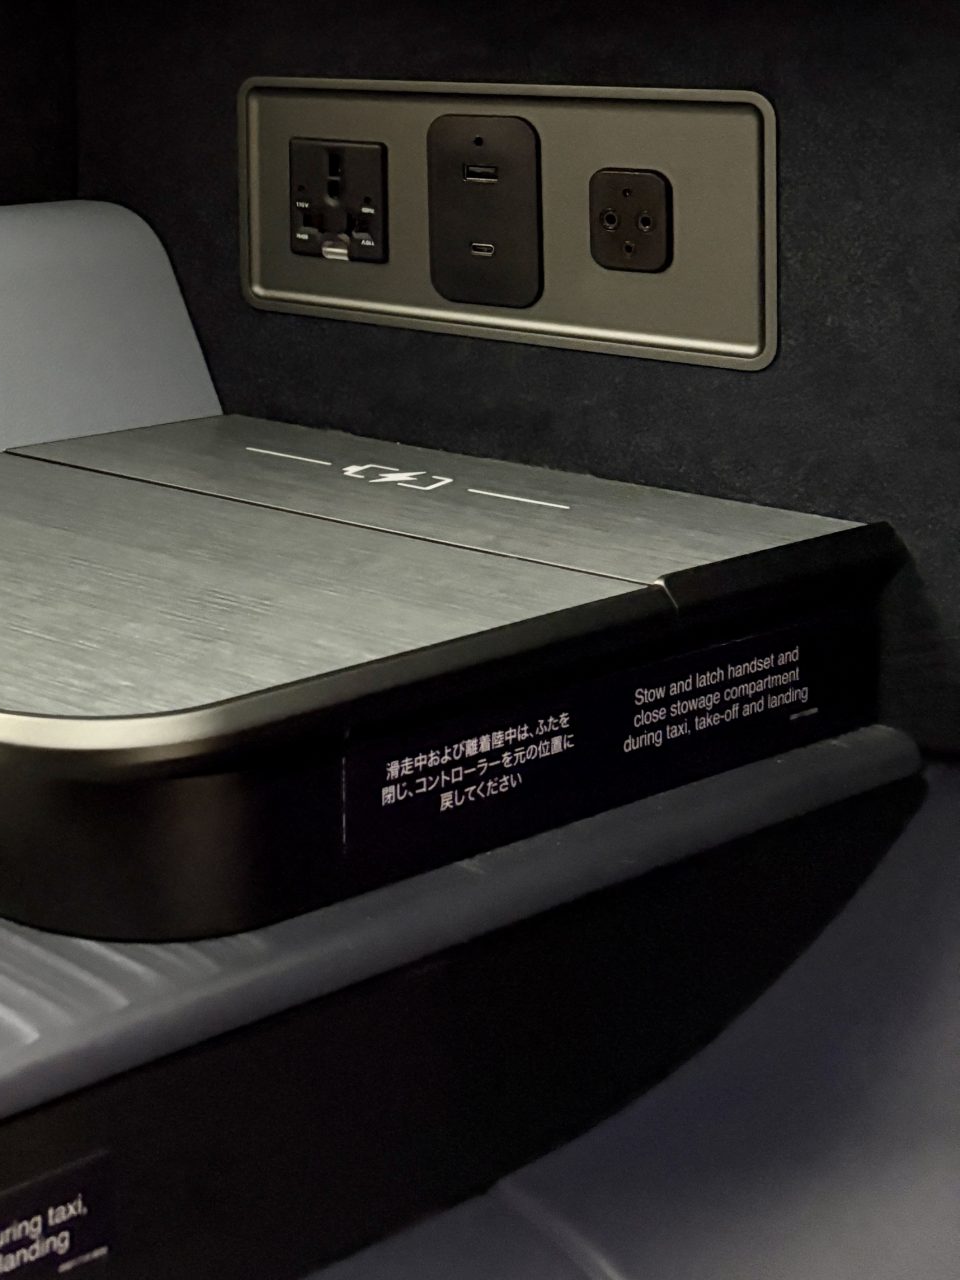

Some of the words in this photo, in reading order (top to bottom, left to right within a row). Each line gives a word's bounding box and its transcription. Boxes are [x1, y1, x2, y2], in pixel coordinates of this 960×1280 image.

[633, 706, 667, 728] close
[670, 691, 721, 718] stowage
[723, 667, 800, 702] compartment
[634, 684, 666, 706] Stow
[669, 675, 693, 697] and
[696, 667, 725, 689] latch
[728, 653, 775, 680] handset
[777, 646, 799, 666] and
[385, 712, 570, 781] 滑走中および離着陸中は、ふたを
[623, 728, 663, 753] during
[666, 719, 691, 740] taxi,
[694, 702, 740, 732] take-off
[742, 695, 765, 718] and
[767, 686, 809, 710] landing
[381, 734, 575, 806] 閉じ、コントローラーを元の位置に
[440, 772, 522, 811] 戻してください
[47, 1193, 88, 1227] taxi,
